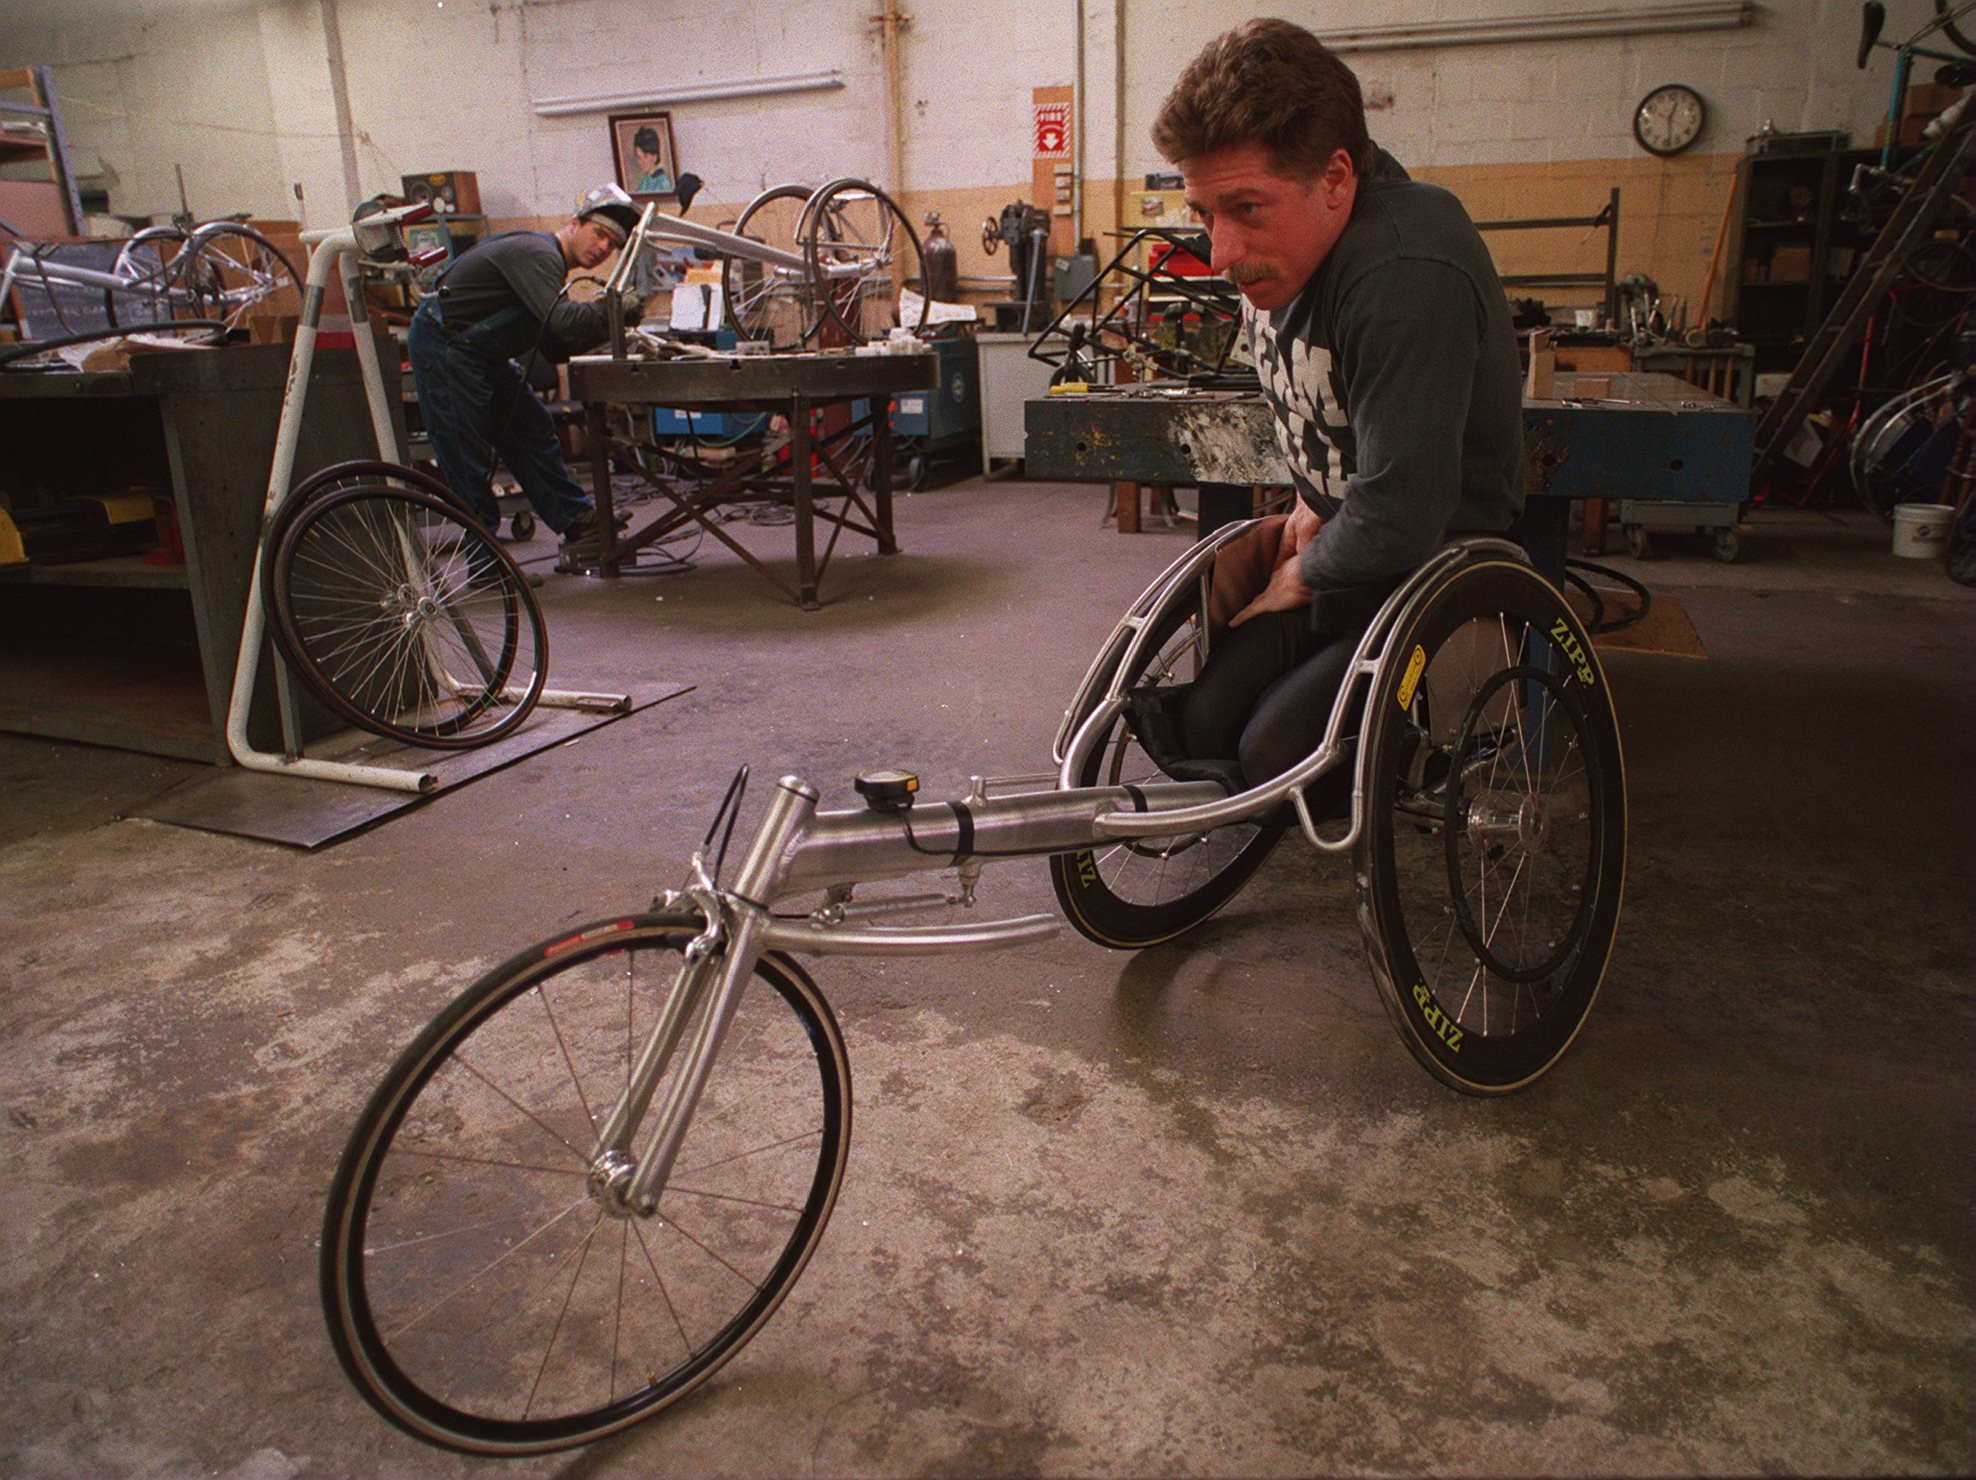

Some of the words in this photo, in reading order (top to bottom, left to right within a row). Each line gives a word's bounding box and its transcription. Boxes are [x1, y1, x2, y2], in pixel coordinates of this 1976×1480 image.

[1039, 112, 1062, 122] FIRE
[1550, 617, 1595, 685] ZIPP
[1076, 848, 1097, 888] ZI
[1413, 985, 1464, 1054] ZIPP
